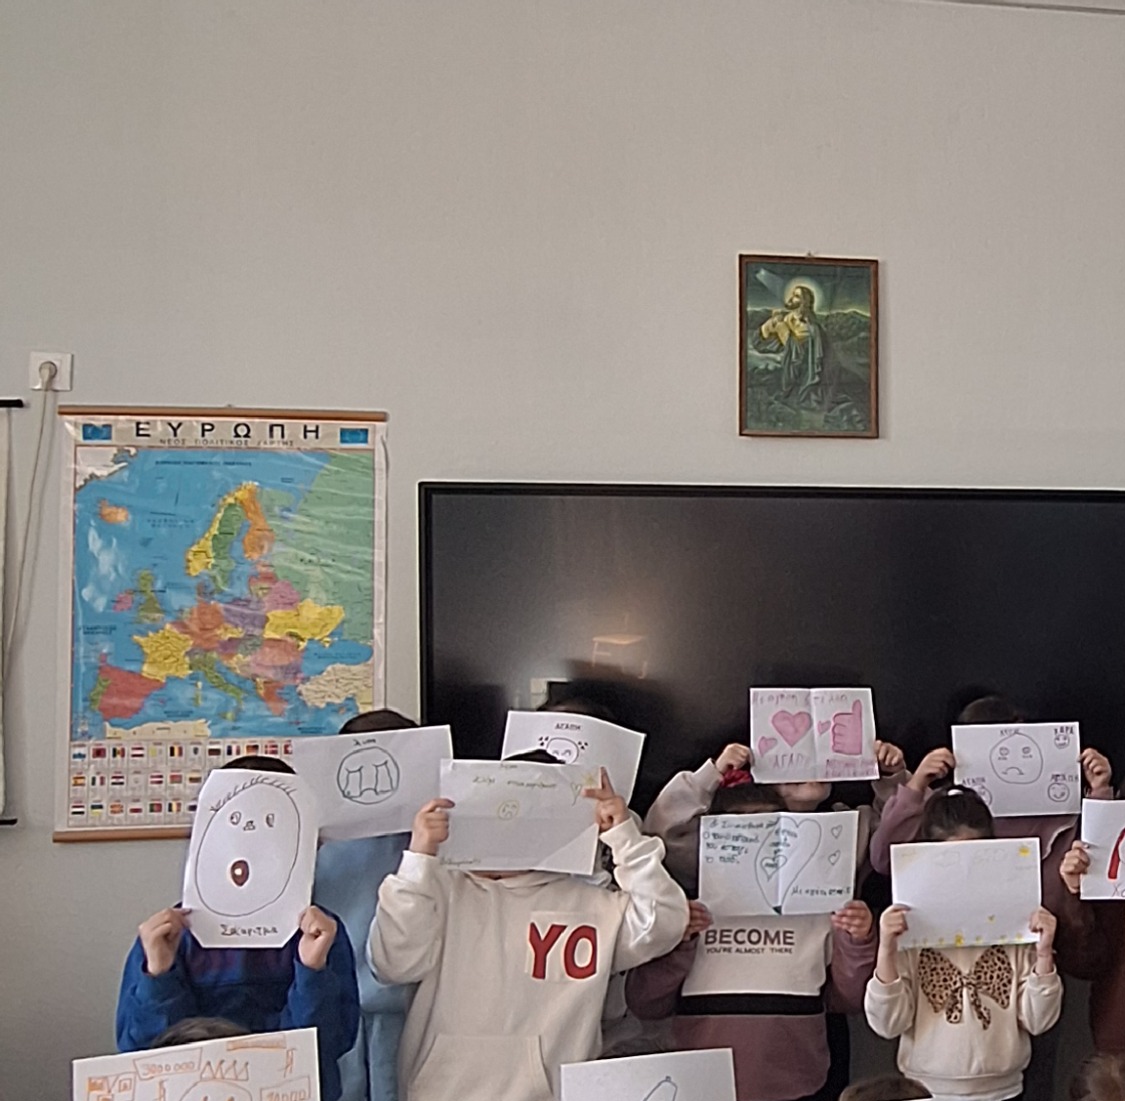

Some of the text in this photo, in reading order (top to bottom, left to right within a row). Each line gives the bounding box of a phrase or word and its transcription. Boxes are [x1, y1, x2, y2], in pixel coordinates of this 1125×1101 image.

[135, 421, 320, 440] ΕΥΡΩΠΗ
[704, 928, 796, 946] BECOME
[529, 922, 598, 980] YO
[735, 946, 766, 954] ALMOST
